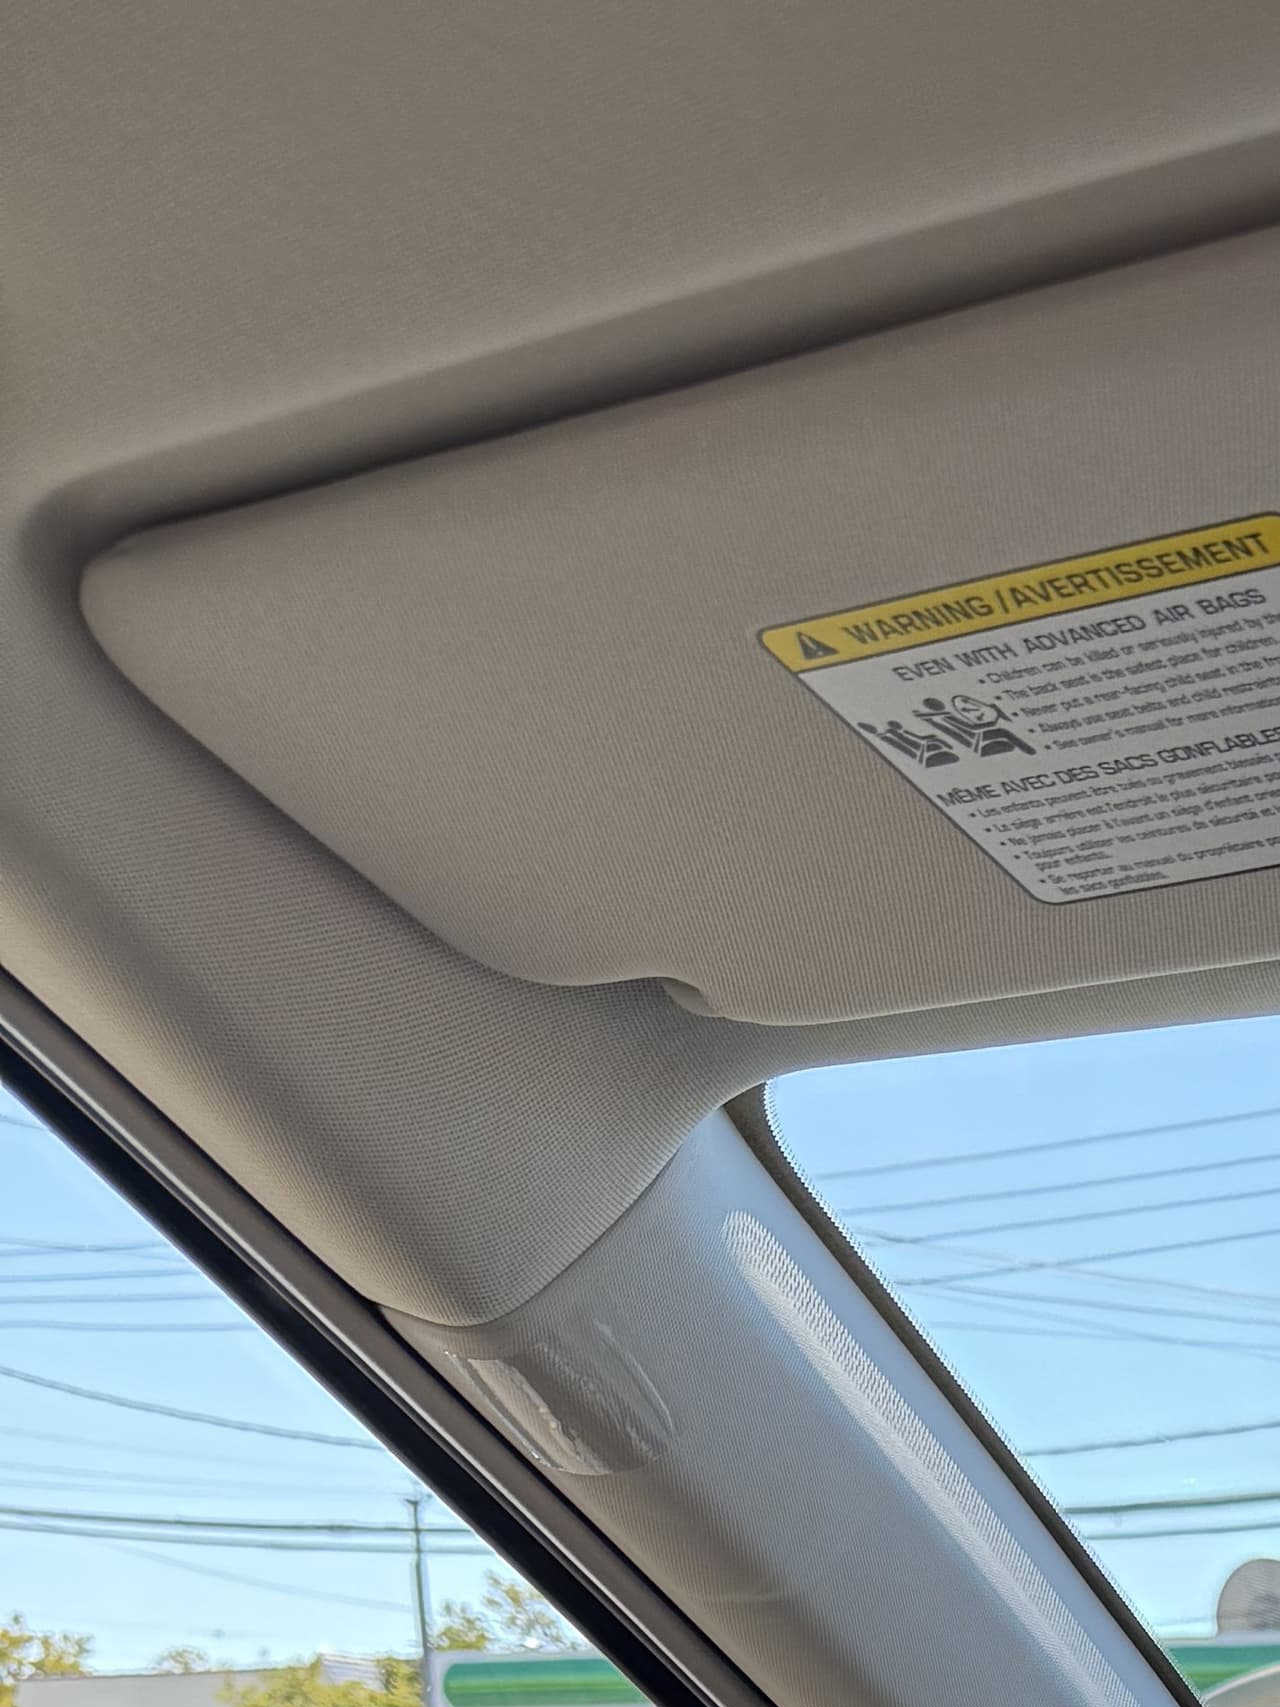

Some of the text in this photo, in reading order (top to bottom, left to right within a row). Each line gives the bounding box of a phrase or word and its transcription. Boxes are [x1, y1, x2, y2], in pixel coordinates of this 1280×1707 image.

[889, 587, 1269, 681] EVEN WITH ADVANCED AIR BAGS
[995, 772, 1058, 795] AVEC
[1051, 764, 1101, 784] DES
[1094, 752, 1161, 775] SACS
